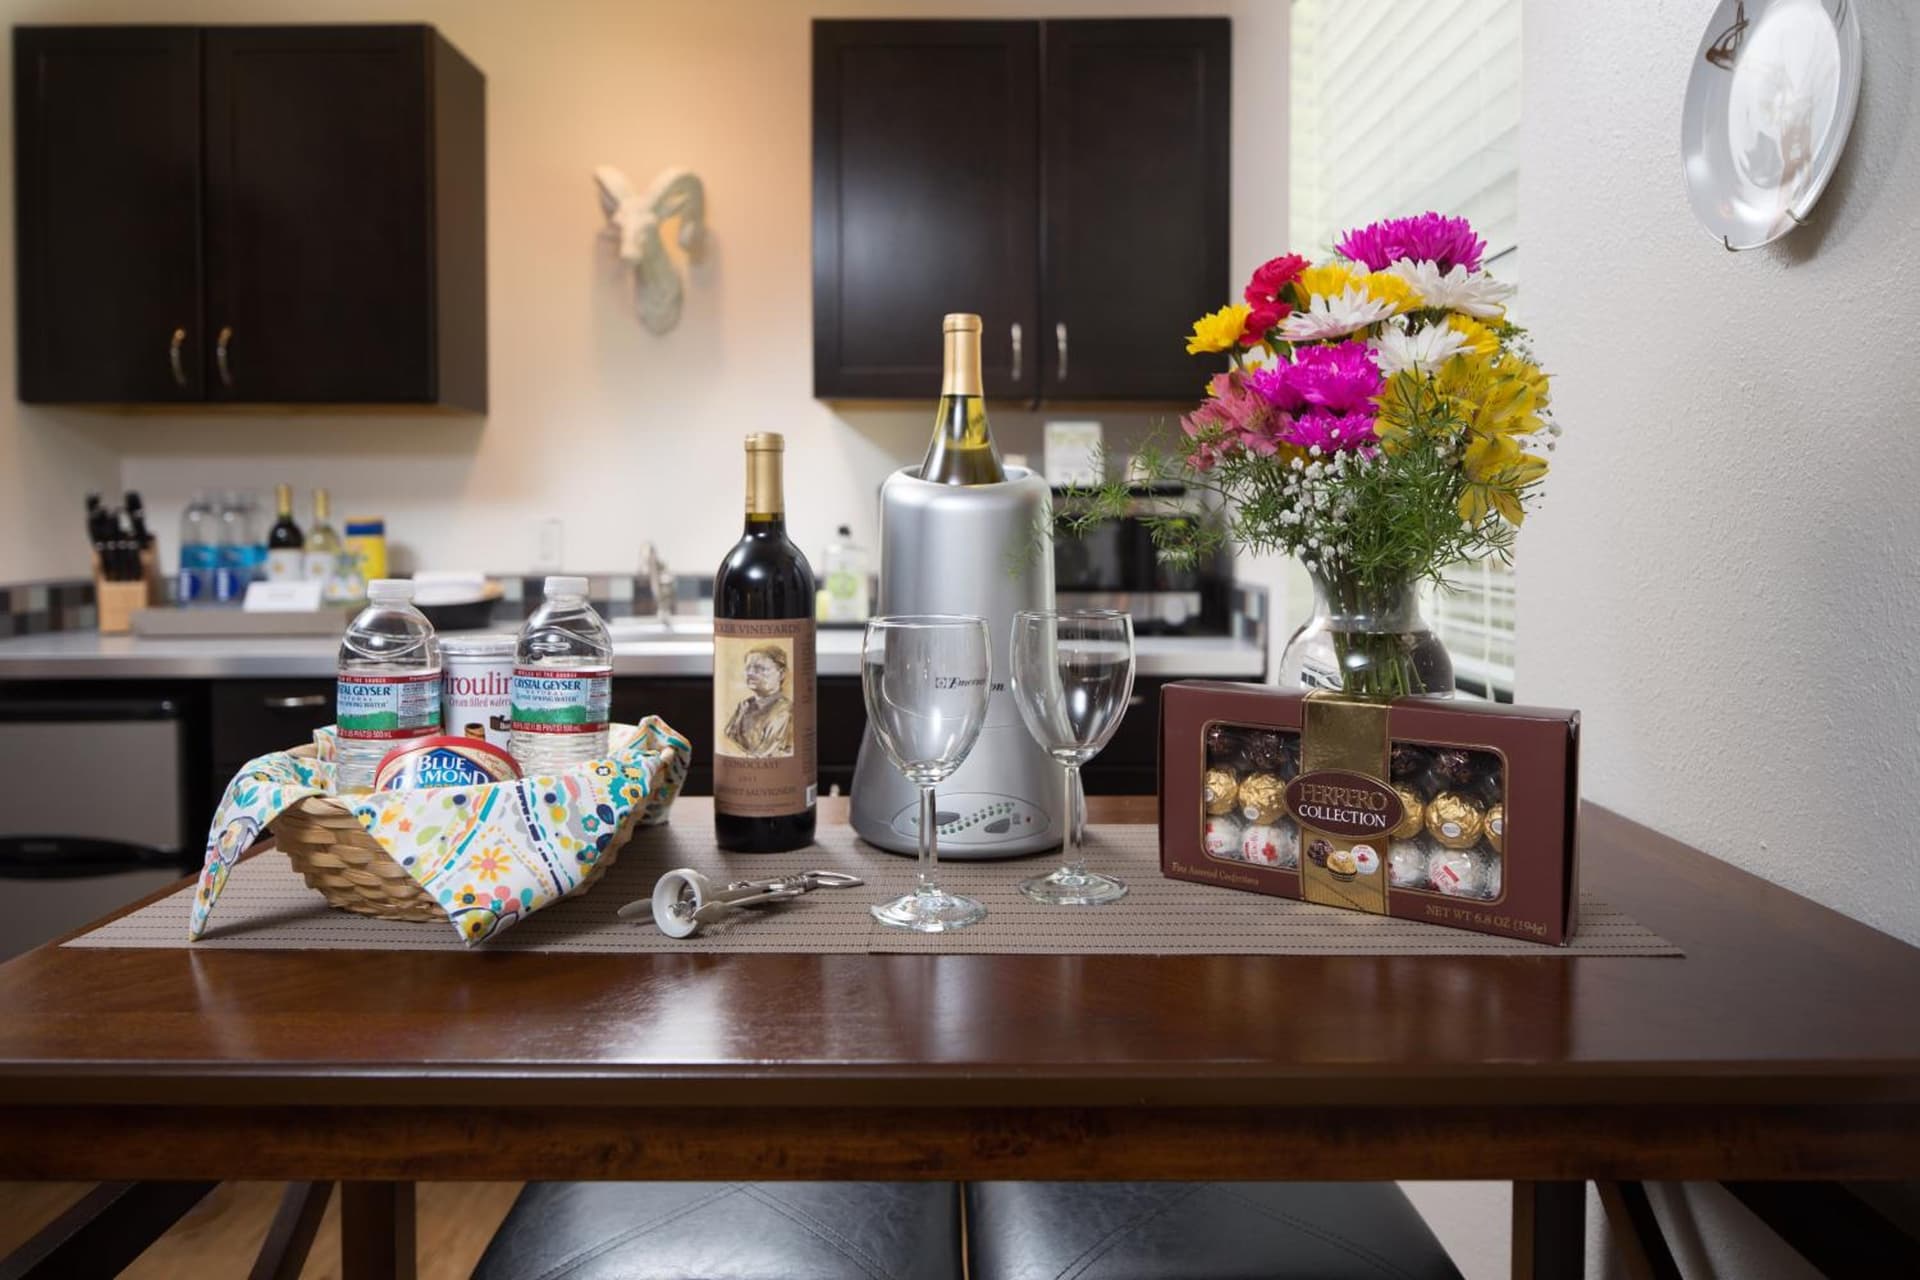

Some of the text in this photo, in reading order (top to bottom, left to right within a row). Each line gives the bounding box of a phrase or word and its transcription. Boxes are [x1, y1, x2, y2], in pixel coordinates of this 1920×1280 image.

[353, 686, 391, 696] GEYSER
[514, 678, 581, 691] CRYSTAL GEYSER
[416, 754, 467, 772] BLUE
[1299, 783, 1388, 812] FERRERO
[1298, 804, 1387, 828] COLLECTION
[1425, 904, 1451, 917] NET
[1452, 907, 1472, 921] WT
[1492, 914, 1512, 928] OZ
